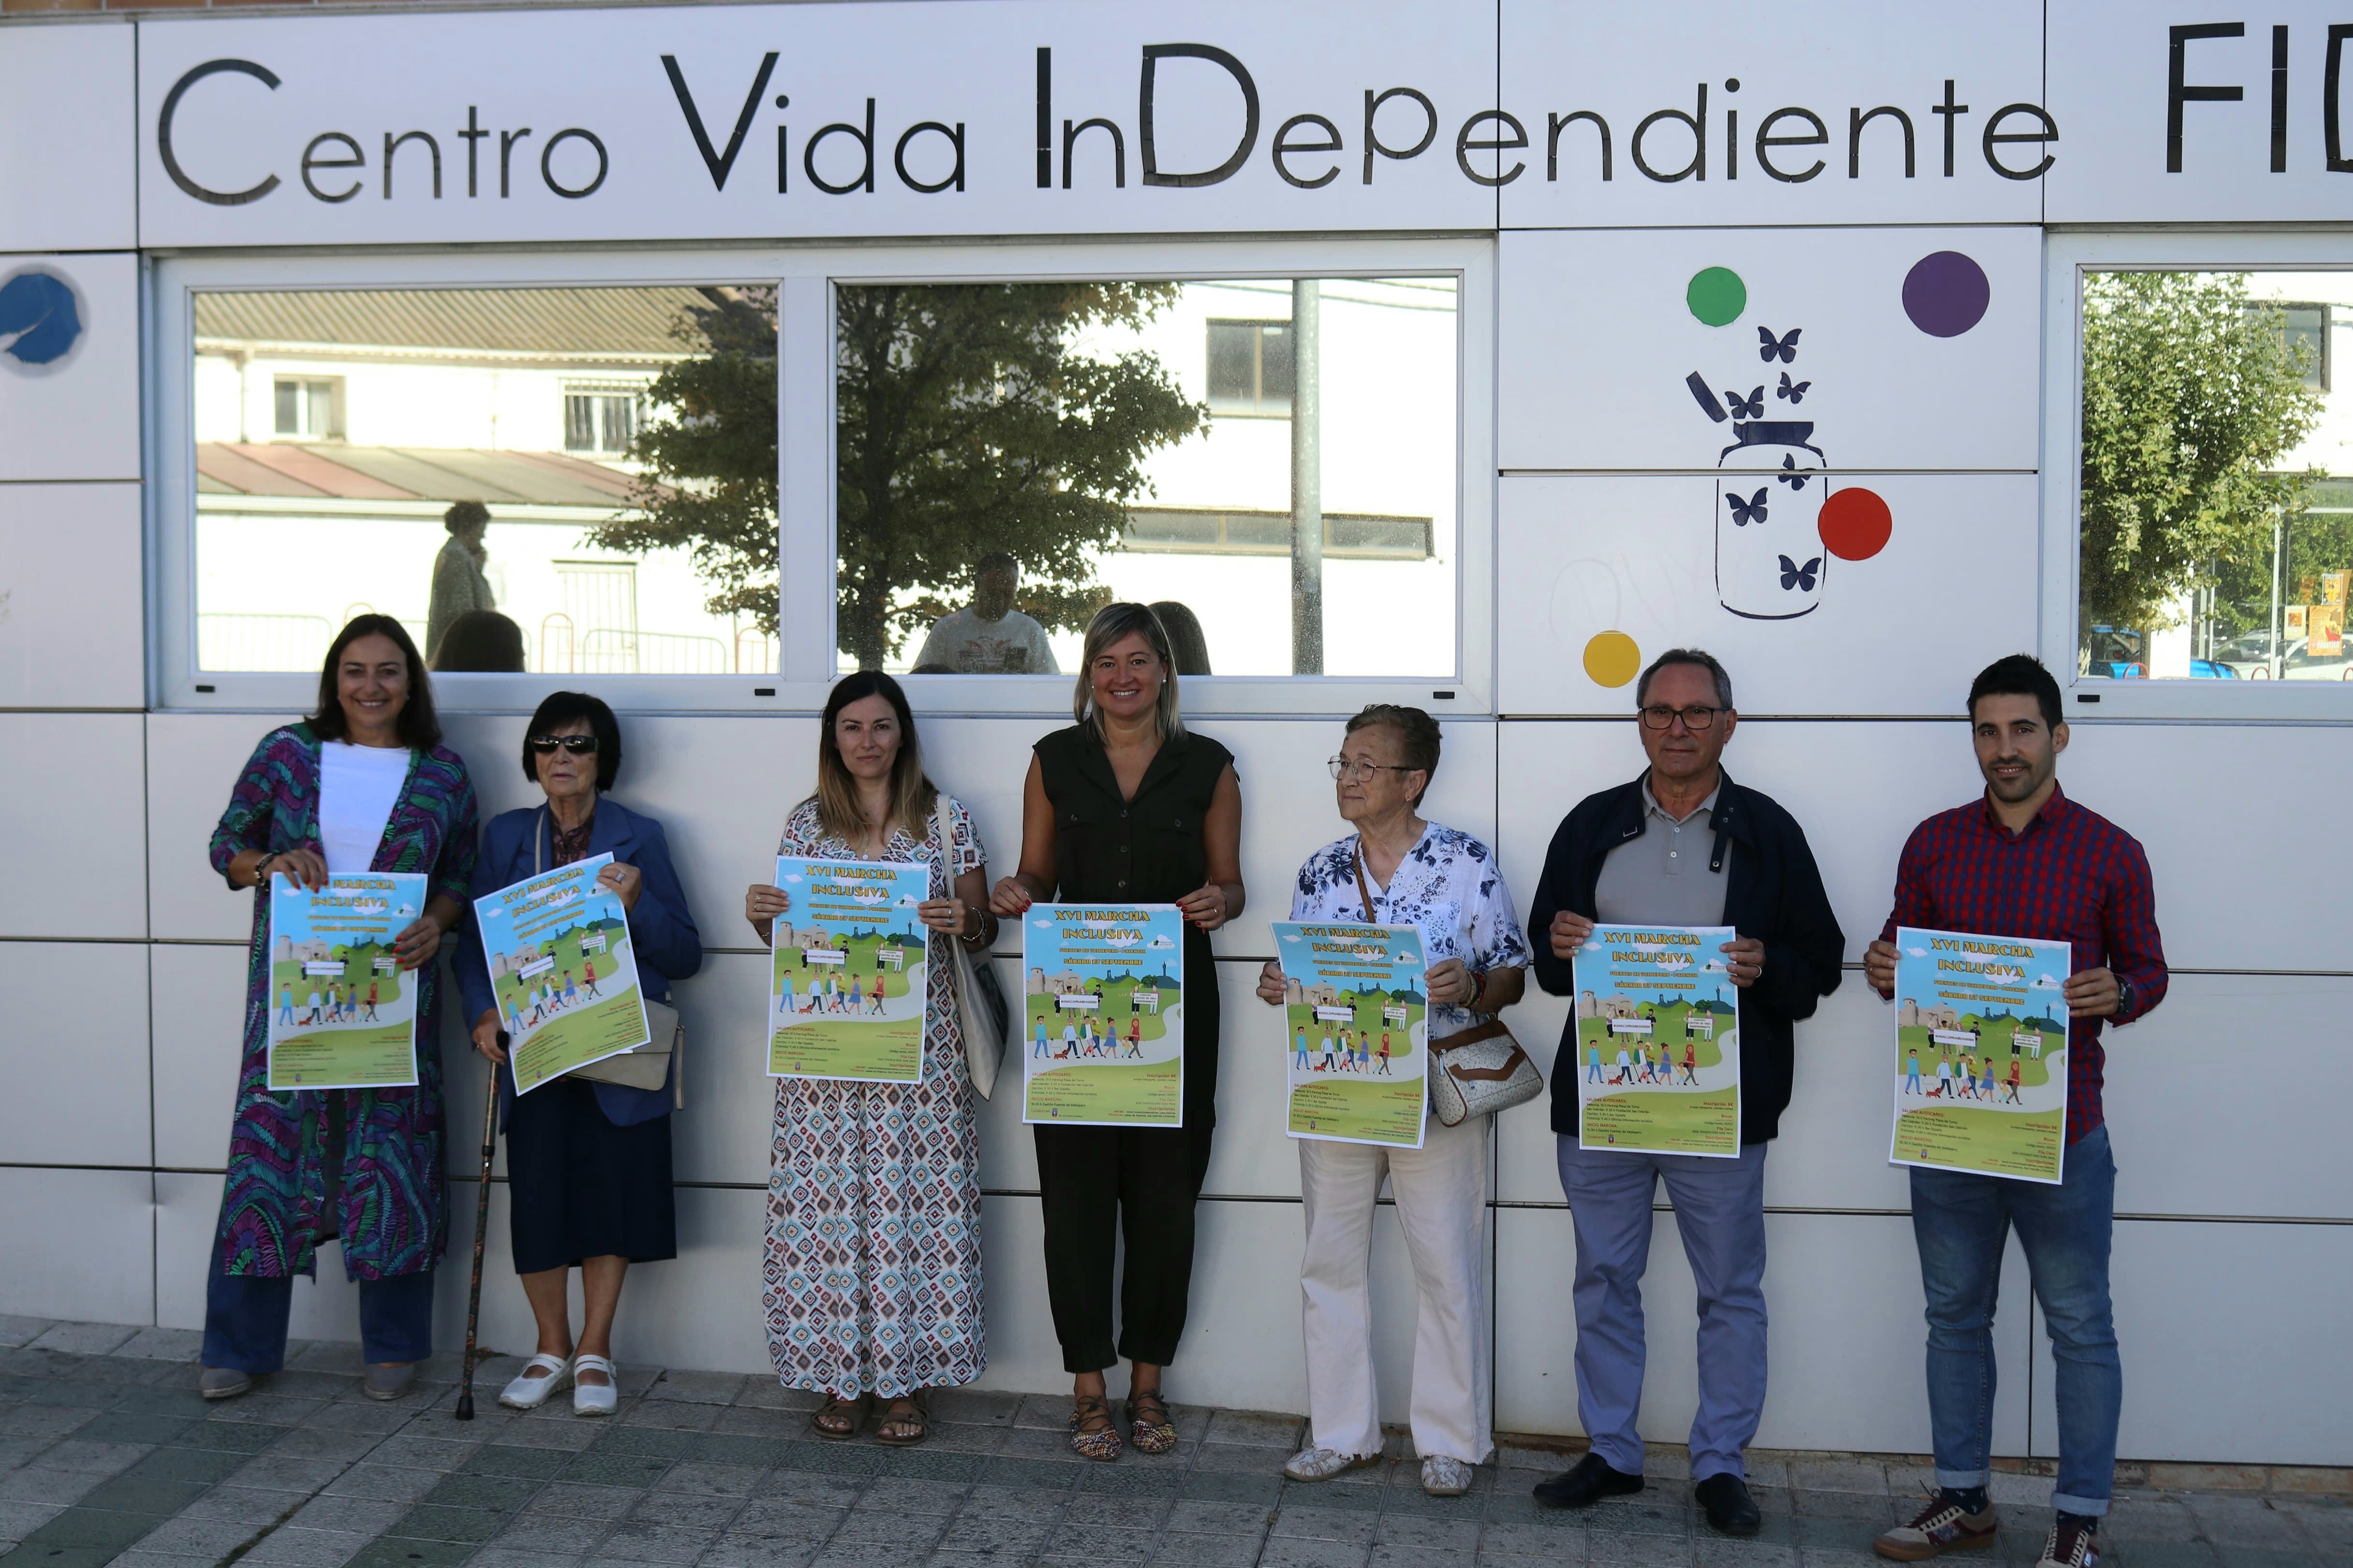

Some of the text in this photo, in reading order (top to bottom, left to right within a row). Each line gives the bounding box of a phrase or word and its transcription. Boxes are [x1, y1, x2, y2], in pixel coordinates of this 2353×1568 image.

[159, 22, 2353, 205] Centro Vida InDependiente FI
[805, 865, 897, 880] XVI MARCHA
[333, 879, 397, 890] MARCHA
[527, 868, 585, 893] MARCHA
[812, 884, 890, 898] INCLUSIVA
[310, 896, 390, 907] INCLUSIVA
[512, 885, 581, 917] INCLUSIVA
[1055, 911, 1150, 921] XVI MARCHA
[1062, 929, 1143, 939] INCLUSIVA
[1300, 927, 1391, 939] XVI MARCHA
[1604, 932, 1701, 945] XVI MARCHA
[1311, 943, 1388, 954] INCLUSIVA
[1931, 938, 2034, 958] XVI MARCHA
[1612, 951, 1695, 963] INCLUSIVA
[1937, 958, 2026, 977] INCLUSIVA
